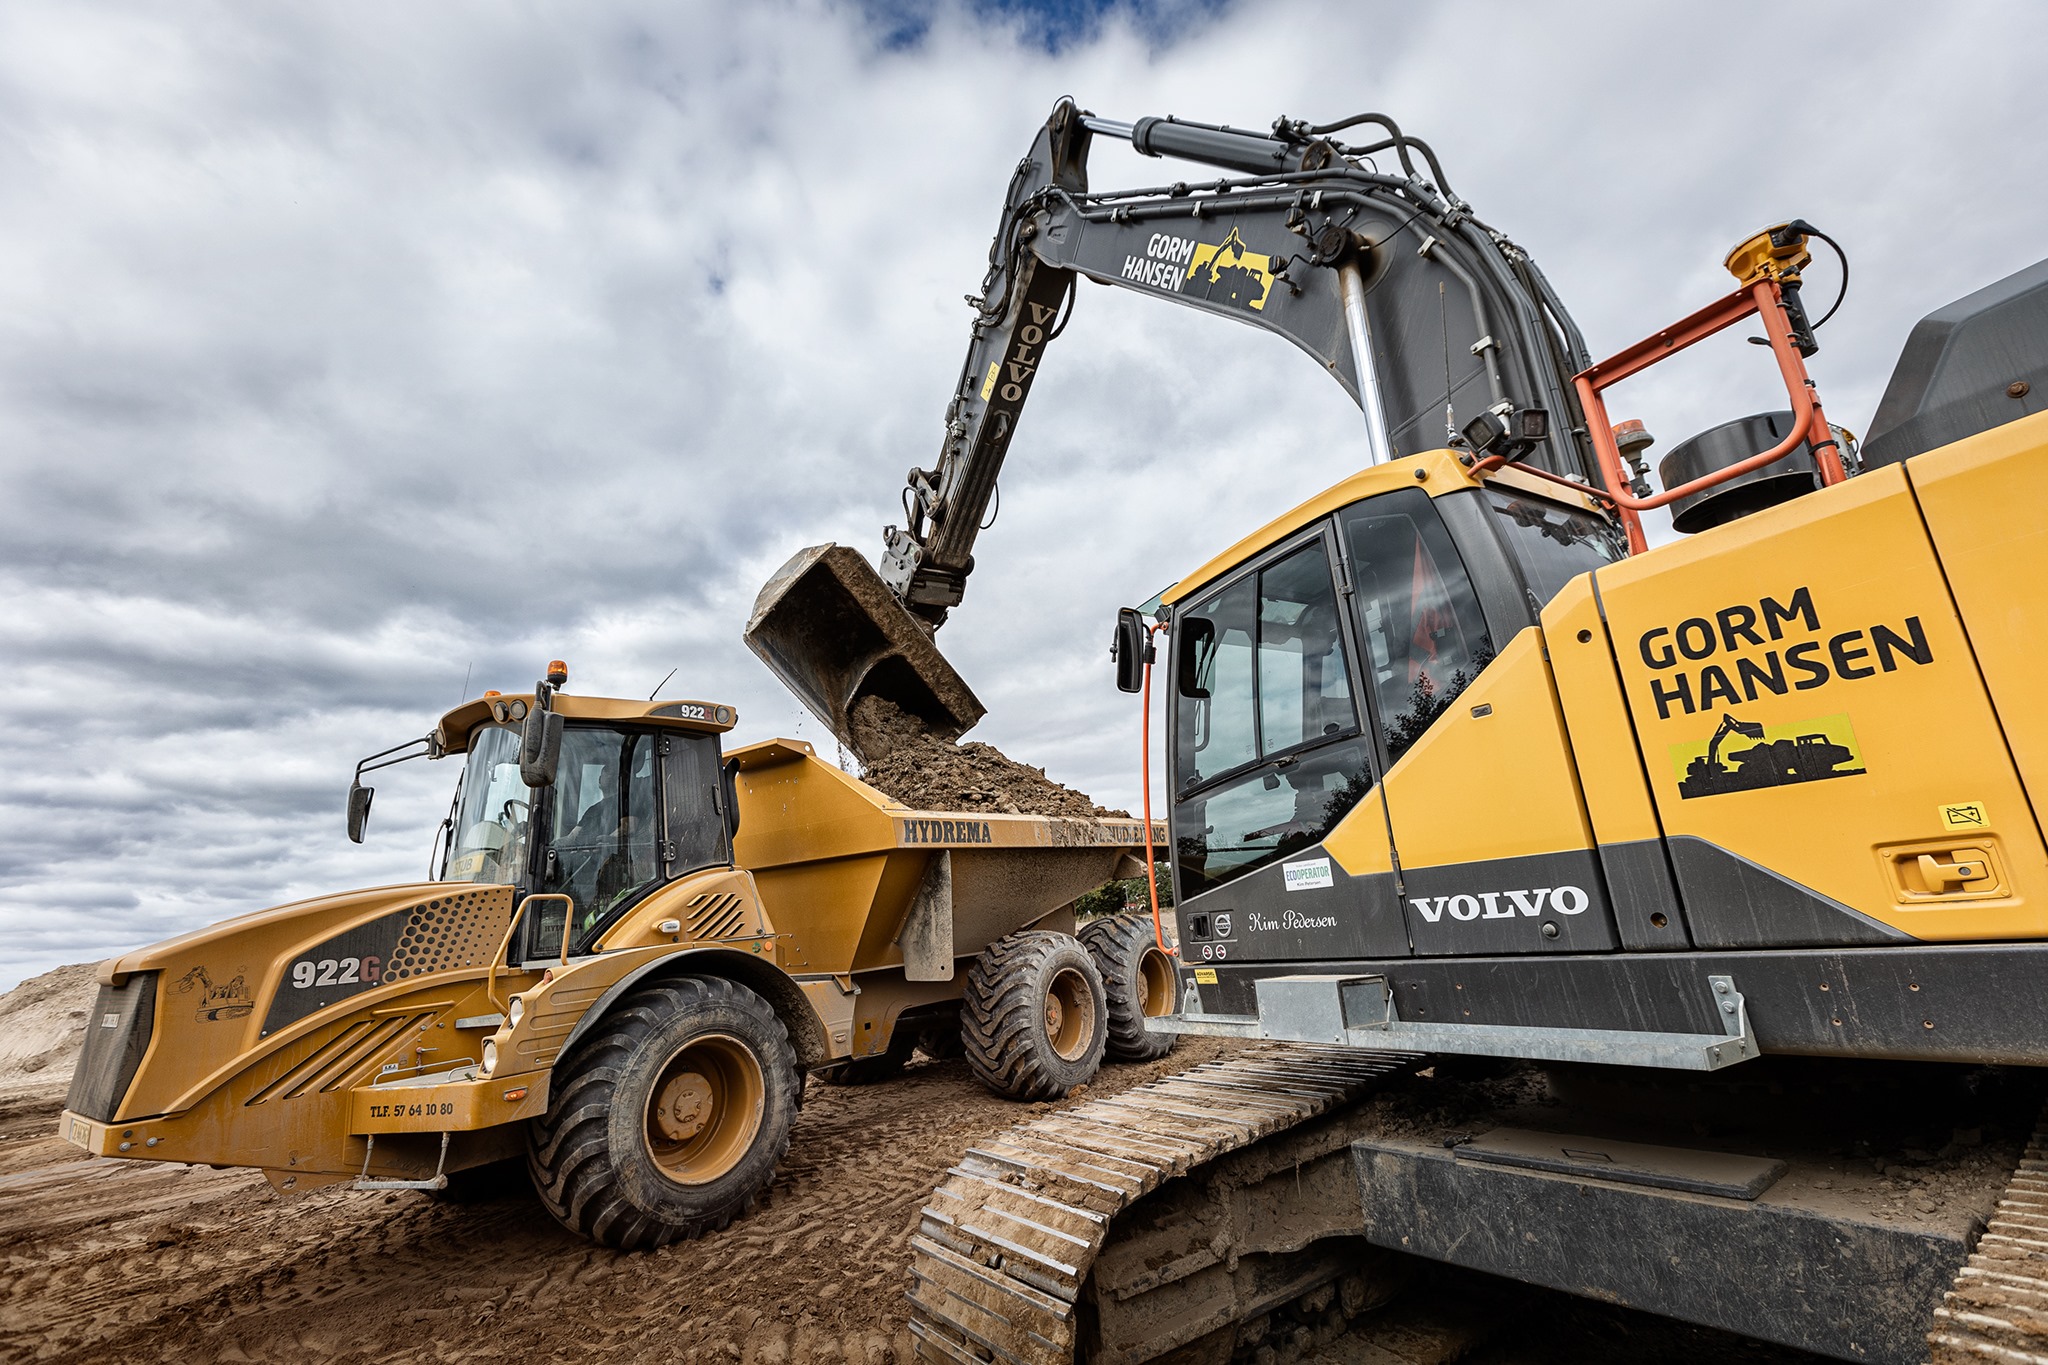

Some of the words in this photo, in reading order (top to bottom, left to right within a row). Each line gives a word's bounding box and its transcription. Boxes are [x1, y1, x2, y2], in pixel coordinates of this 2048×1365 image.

[1147, 233, 1195, 265] GORM
[1121, 255, 1185, 292] HANSEN
[1001, 302, 1057, 401] VOLVO
[1639, 586, 1821, 669] GORM
[1650, 616, 1934, 720] HANSEN
[681, 704, 712, 720] 922G
[904, 820, 992, 843] HYDREMA
[1409, 885, 1589, 923] VOLVO
[544, 923, 583, 932] HYDMA
[1249, 912, 1280, 932] Kim
[1282, 910, 1338, 930] Pedersen
[292, 956, 381, 989] 922G
[370, 1105, 391, 1118] TLF.
[393, 1104, 406, 1117] 57
[408, 1103, 422, 1116] 64
[425, 1103, 437, 1116] 10
[440, 1102, 453, 1115] 80
